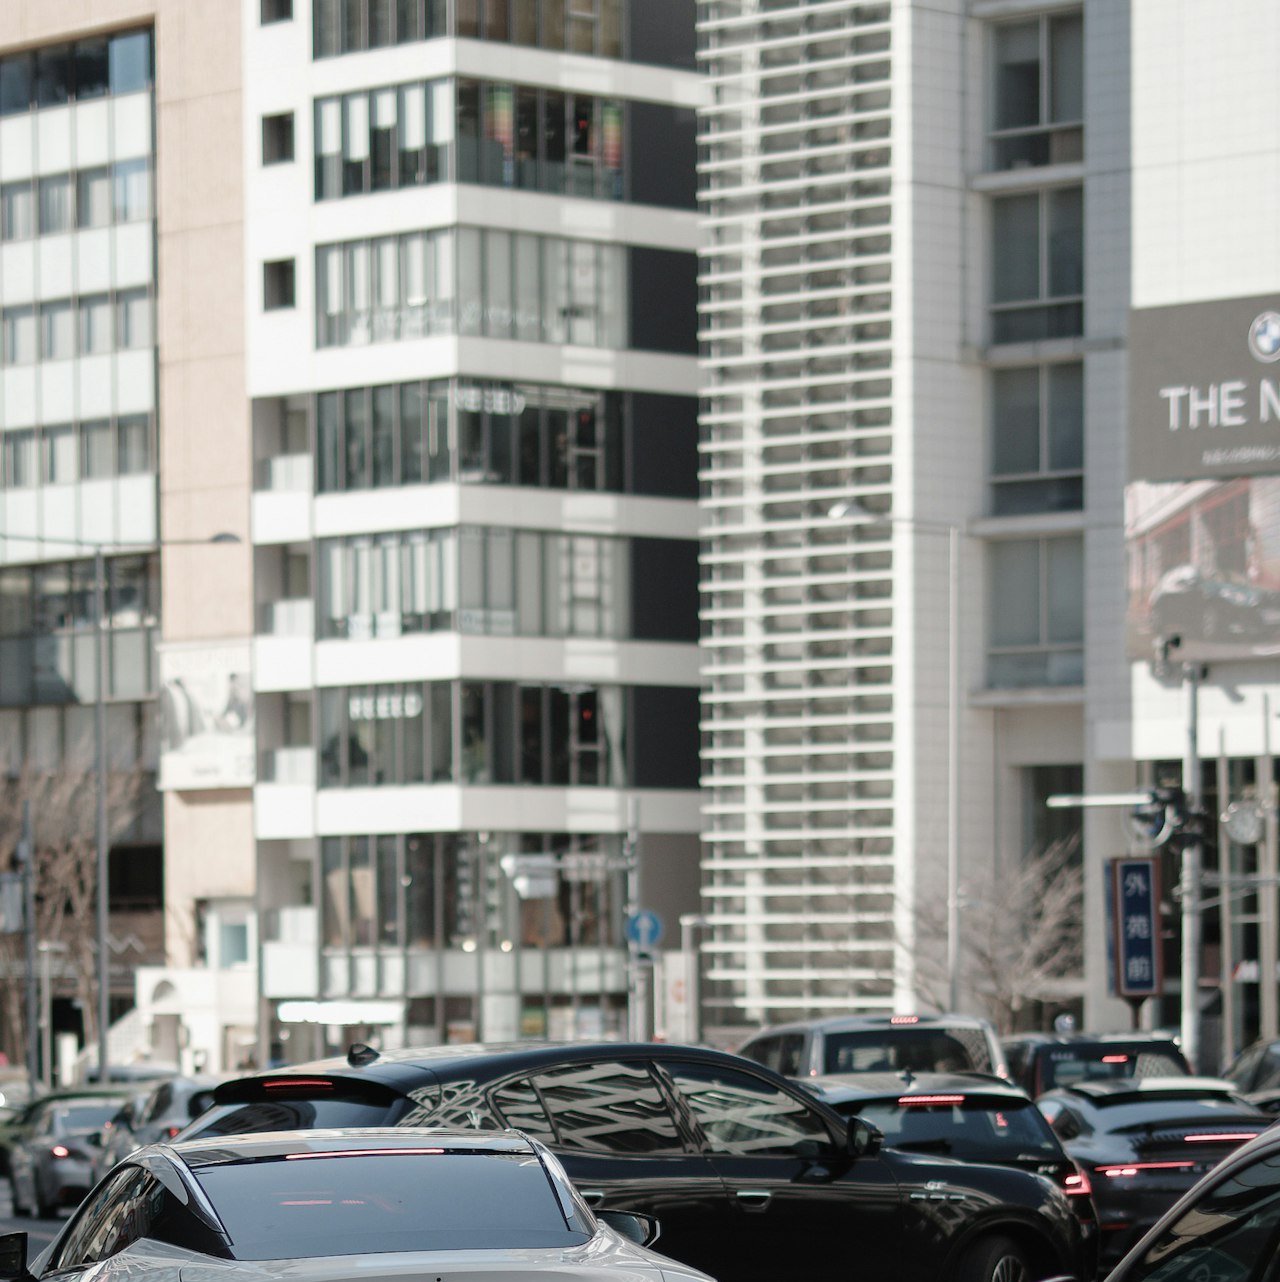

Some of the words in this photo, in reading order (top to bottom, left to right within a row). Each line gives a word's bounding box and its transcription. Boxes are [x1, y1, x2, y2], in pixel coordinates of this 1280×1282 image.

[1158, 380, 1248, 432] THE
[1124, 871, 1152, 982] 外苑前
